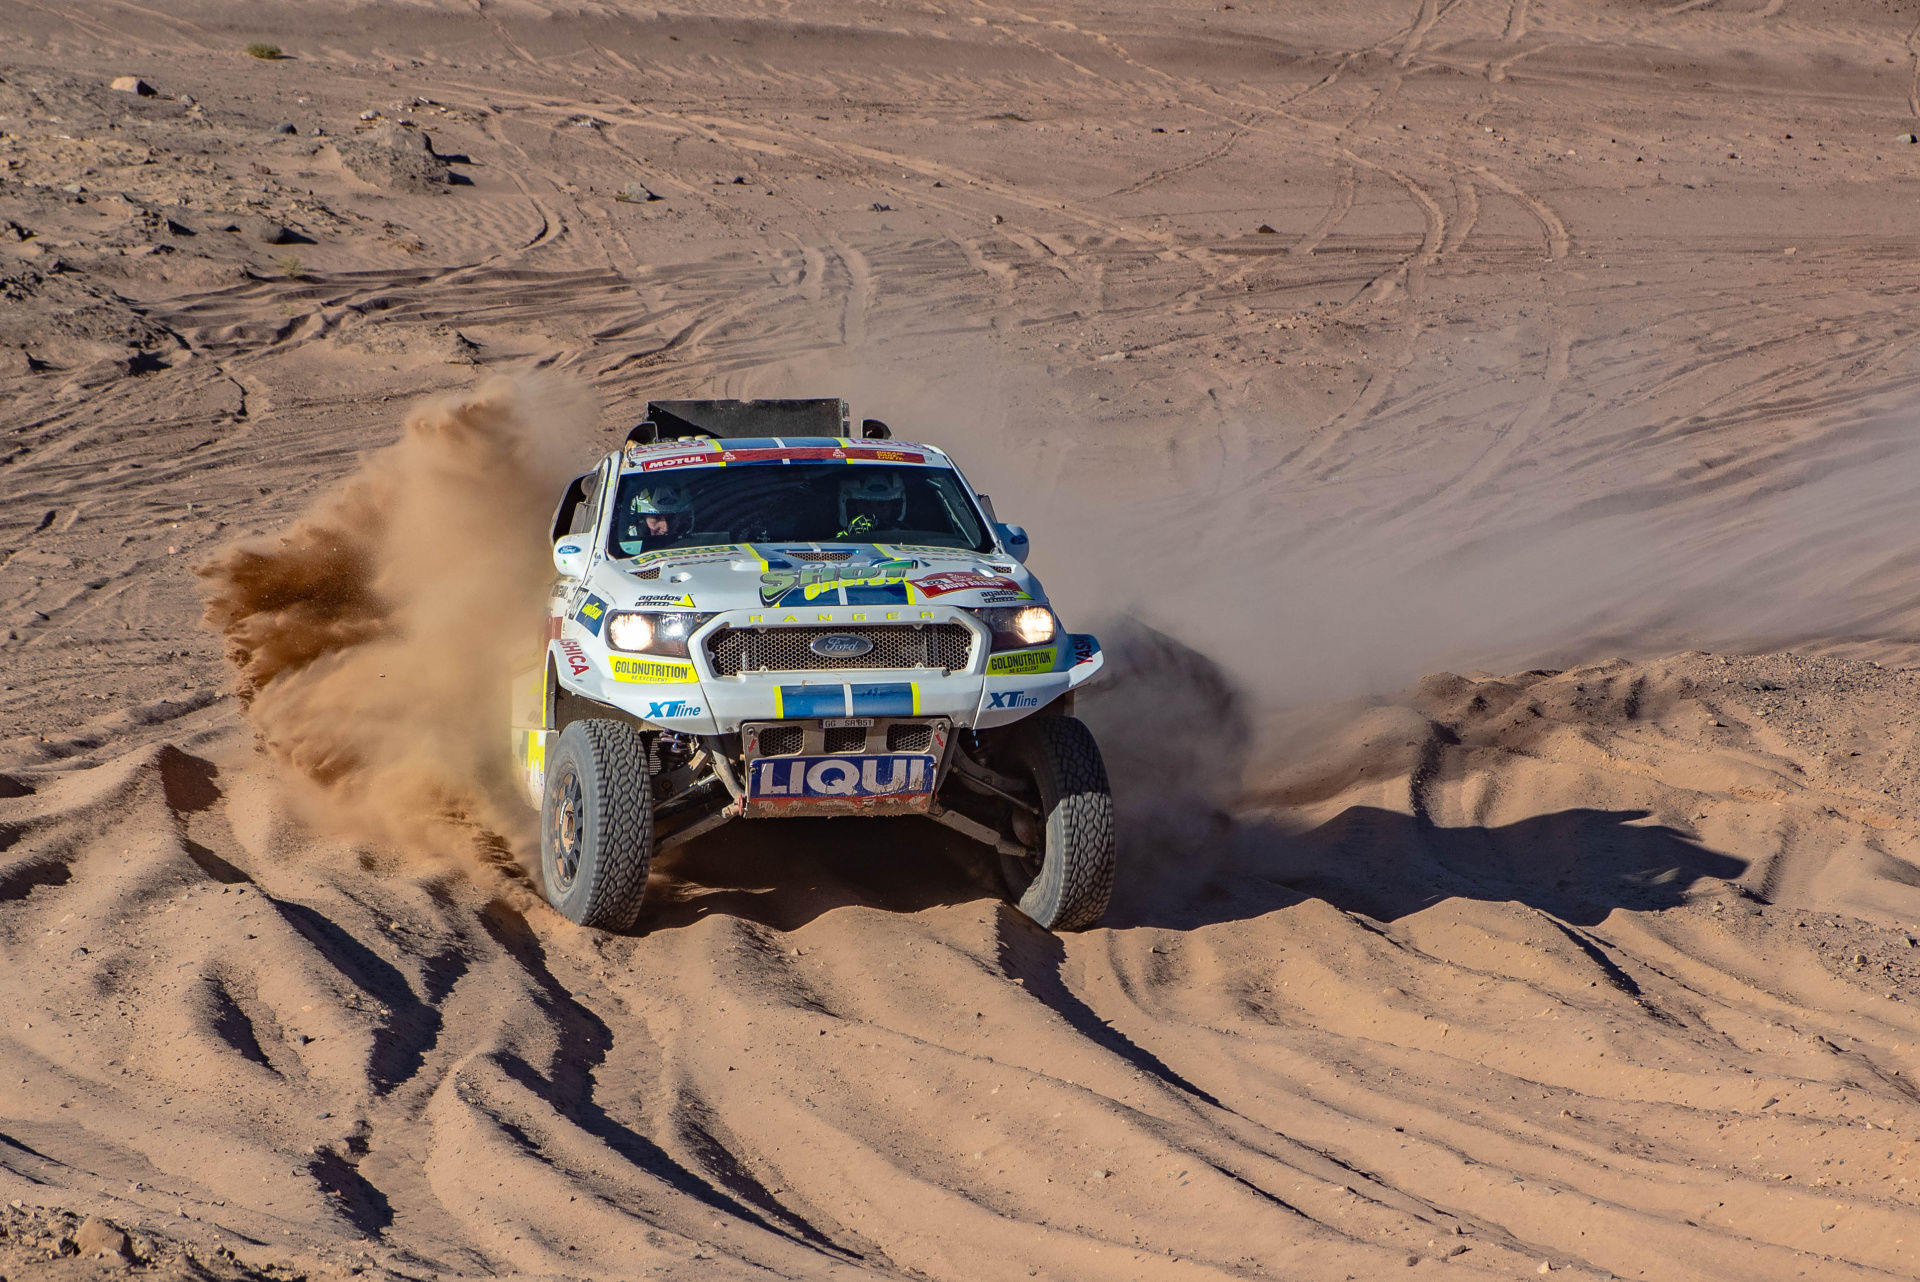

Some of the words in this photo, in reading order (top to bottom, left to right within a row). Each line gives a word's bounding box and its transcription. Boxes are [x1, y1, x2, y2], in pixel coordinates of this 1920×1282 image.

[648, 455, 703, 469] MOTUL
[759, 559, 918, 608] SHOT
[638, 593, 682, 602] agados
[980, 588, 1019, 599] agados
[749, 611, 934, 624] RANGER
[824, 636, 858, 653] Ford
[614, 660, 689, 679] GOLDNUTRITION
[991, 651, 1052, 671] GOLDNUTRITION
[985, 690, 1038, 709] XTline
[643, 700, 701, 719] XTline
[759, 759, 925, 796] LIQUI
